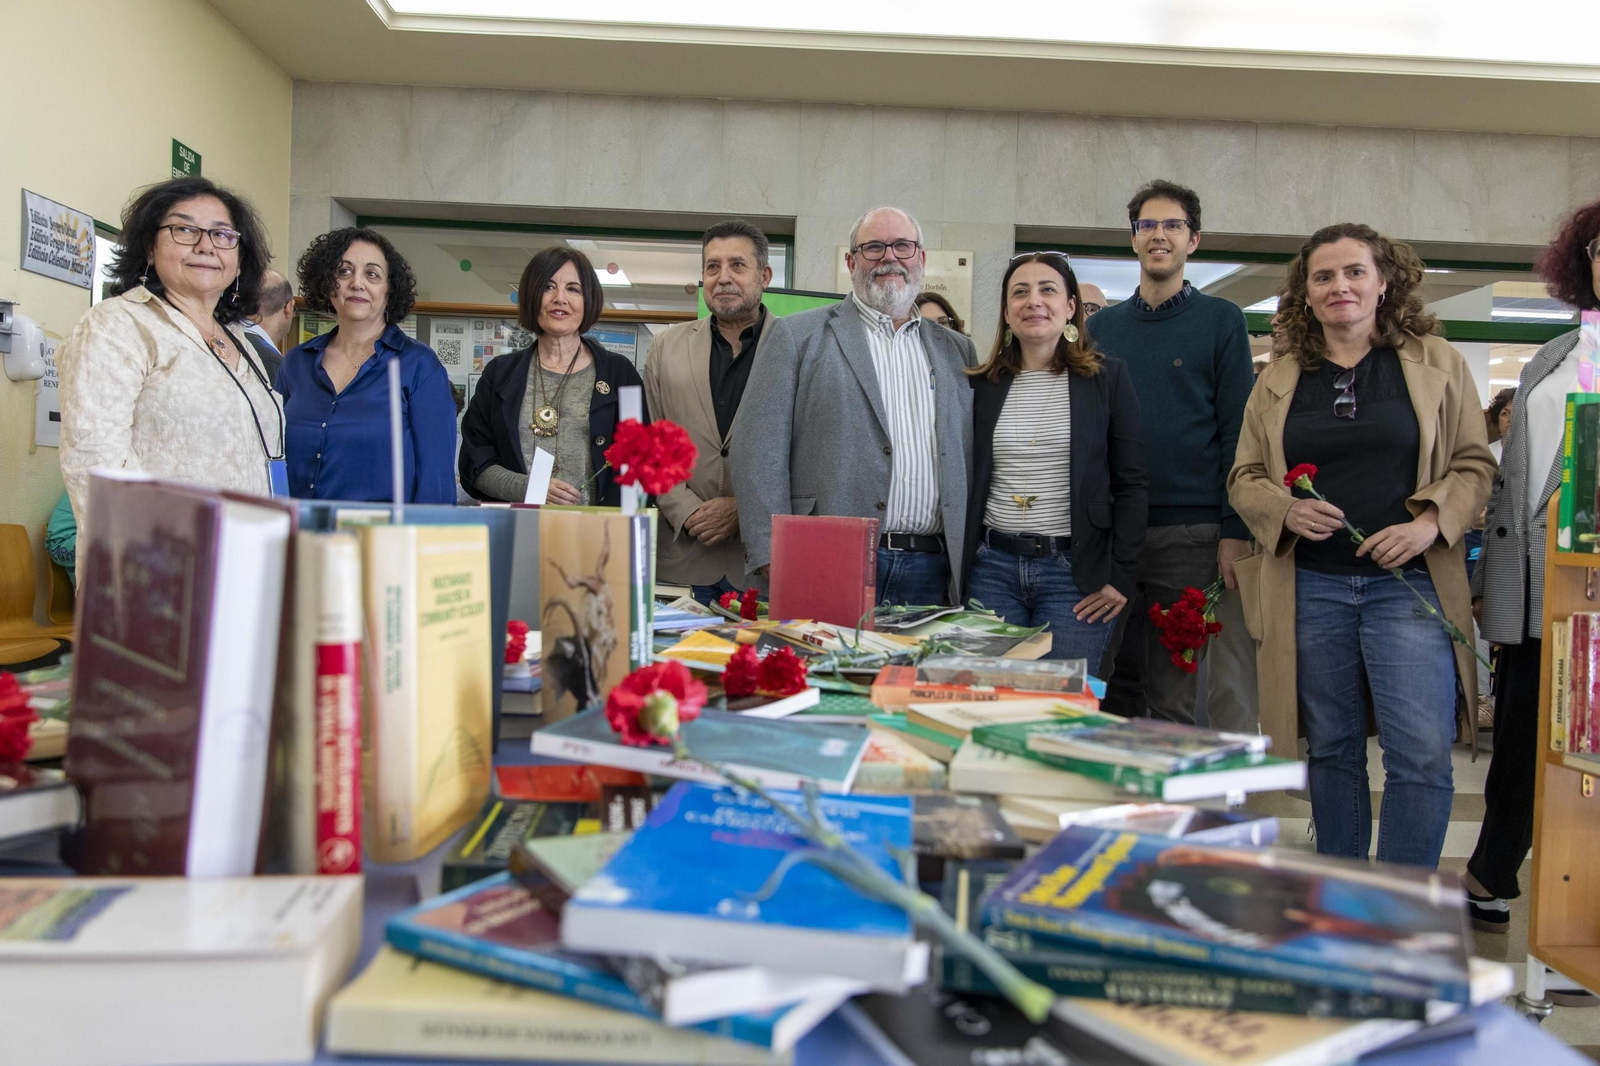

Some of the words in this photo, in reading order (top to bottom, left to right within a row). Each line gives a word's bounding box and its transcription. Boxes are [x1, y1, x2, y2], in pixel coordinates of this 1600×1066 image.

[179, 145, 196, 165] SALIDA
[183, 161, 191, 174] DE
[29, 208, 48, 228] Edificio
[30, 225, 49, 246] Edificio
[27, 243, 49, 263] Edificio
[48, 250, 71, 270] Celestino
[925, 283, 947, 291] Borbón
[1565, 401, 1574, 419] SOLAR
[1563, 420, 1574, 457] ENGINEERING
[1561, 468, 1570, 484] 1995
